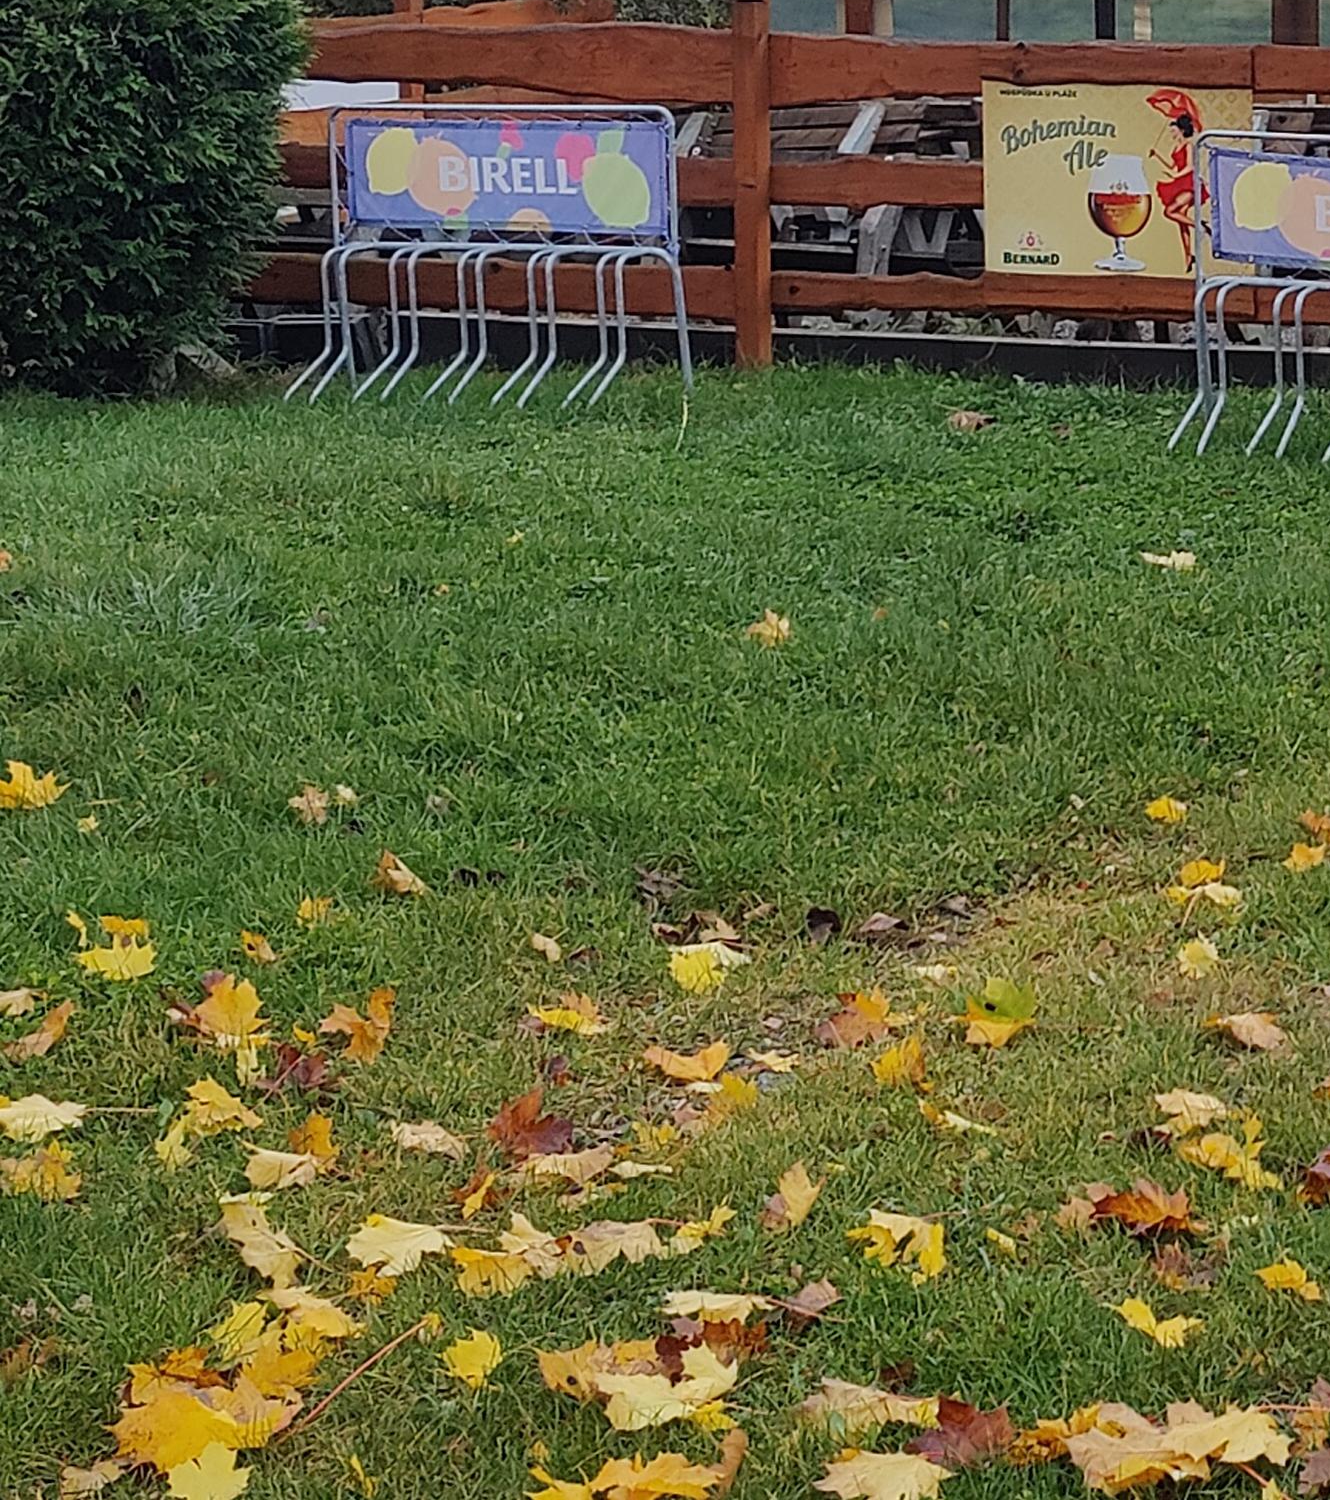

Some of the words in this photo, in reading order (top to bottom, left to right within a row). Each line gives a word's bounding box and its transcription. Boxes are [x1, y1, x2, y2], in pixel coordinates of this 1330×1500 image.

[1000, 114, 1117, 156] Bohemian
[437, 155, 579, 195] BIRELL
[1063, 140, 1109, 177] Ale
[1002, 251, 1061, 266] BERNARD
